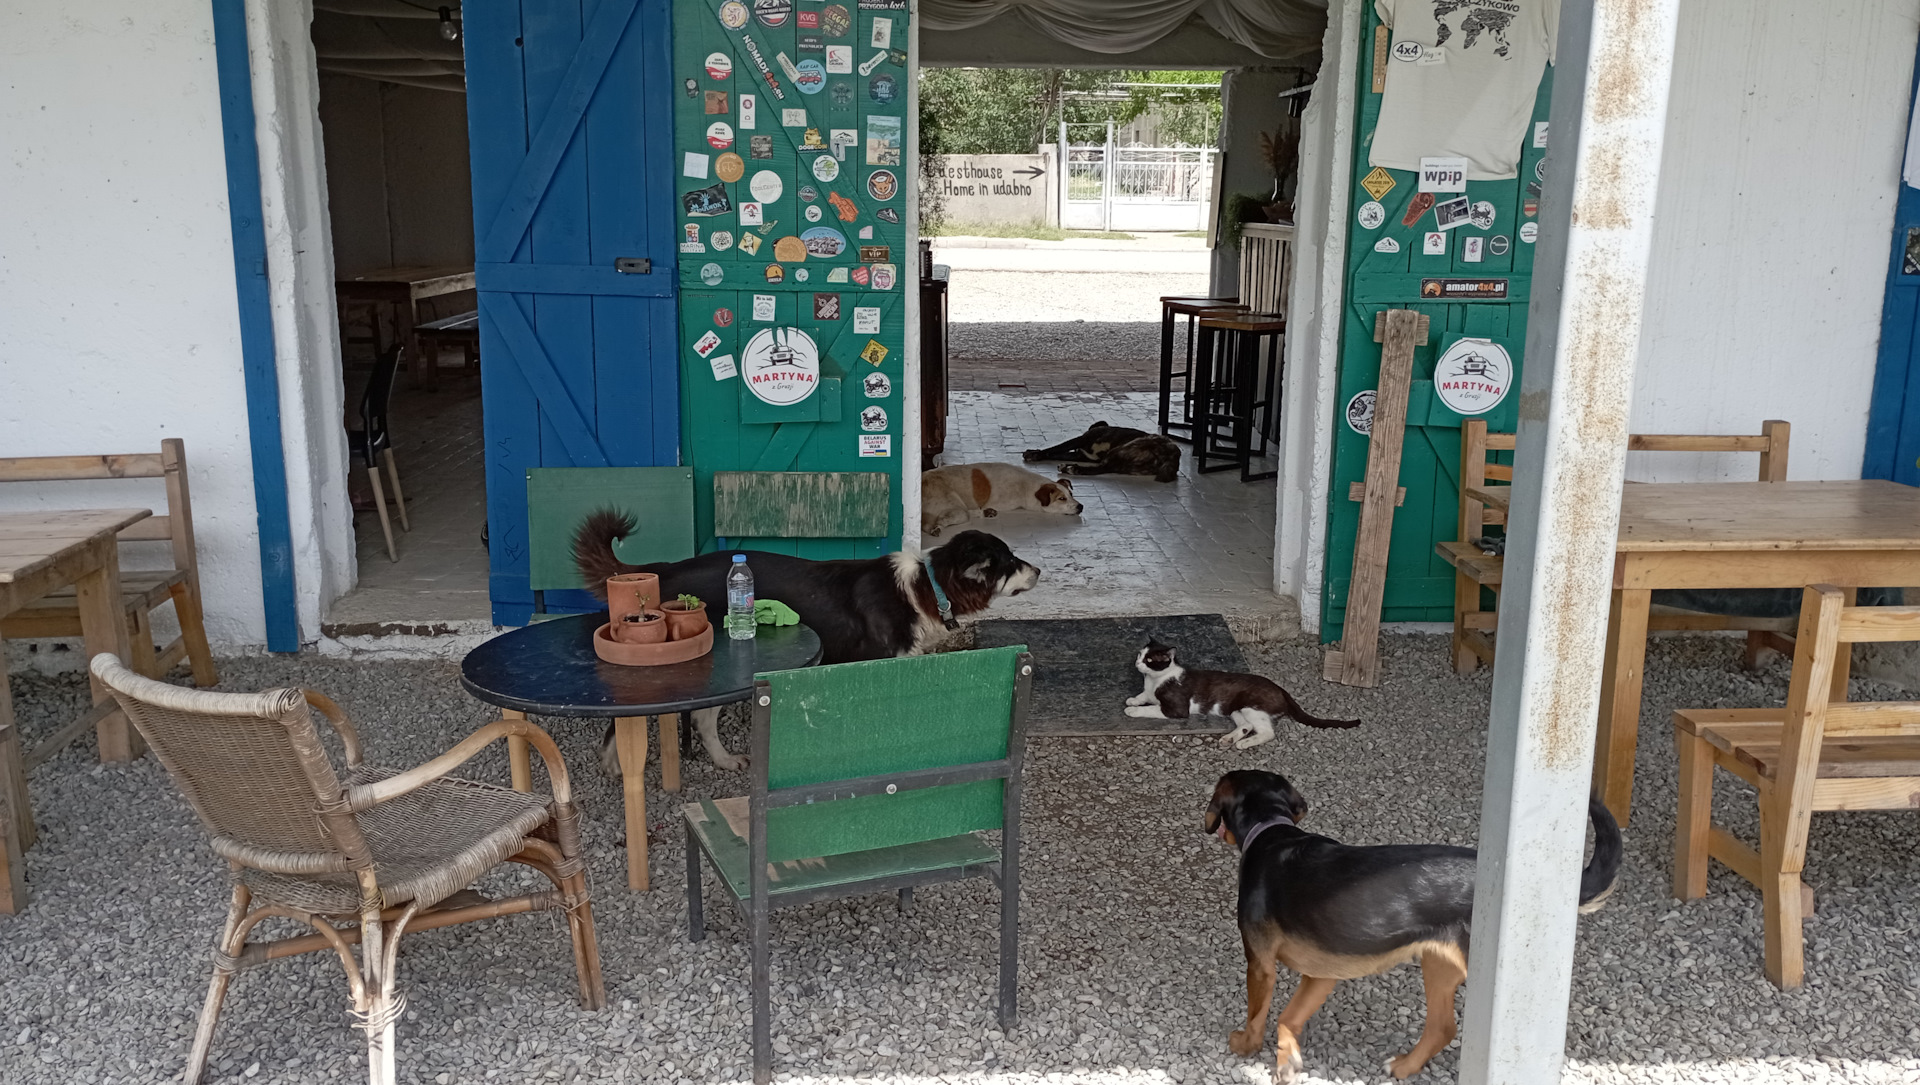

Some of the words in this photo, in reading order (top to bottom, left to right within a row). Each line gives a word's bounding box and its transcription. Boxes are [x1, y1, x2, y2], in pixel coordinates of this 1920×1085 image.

[800, 13, 816, 21] KVG
[824, 8, 850, 28] REGGAE
[1396, 44, 1418, 55] 4x4
[1425, 171, 1462, 185] wpip
[944, 179, 975, 196] Home
[979, 182, 989, 196] in
[993, 179, 1032, 196] udabno
[1446, 282, 1504, 292] amator4x4.pl
[752, 372, 813, 384] MARTYNA
[1442, 381, 1500, 395] MARTYNA
